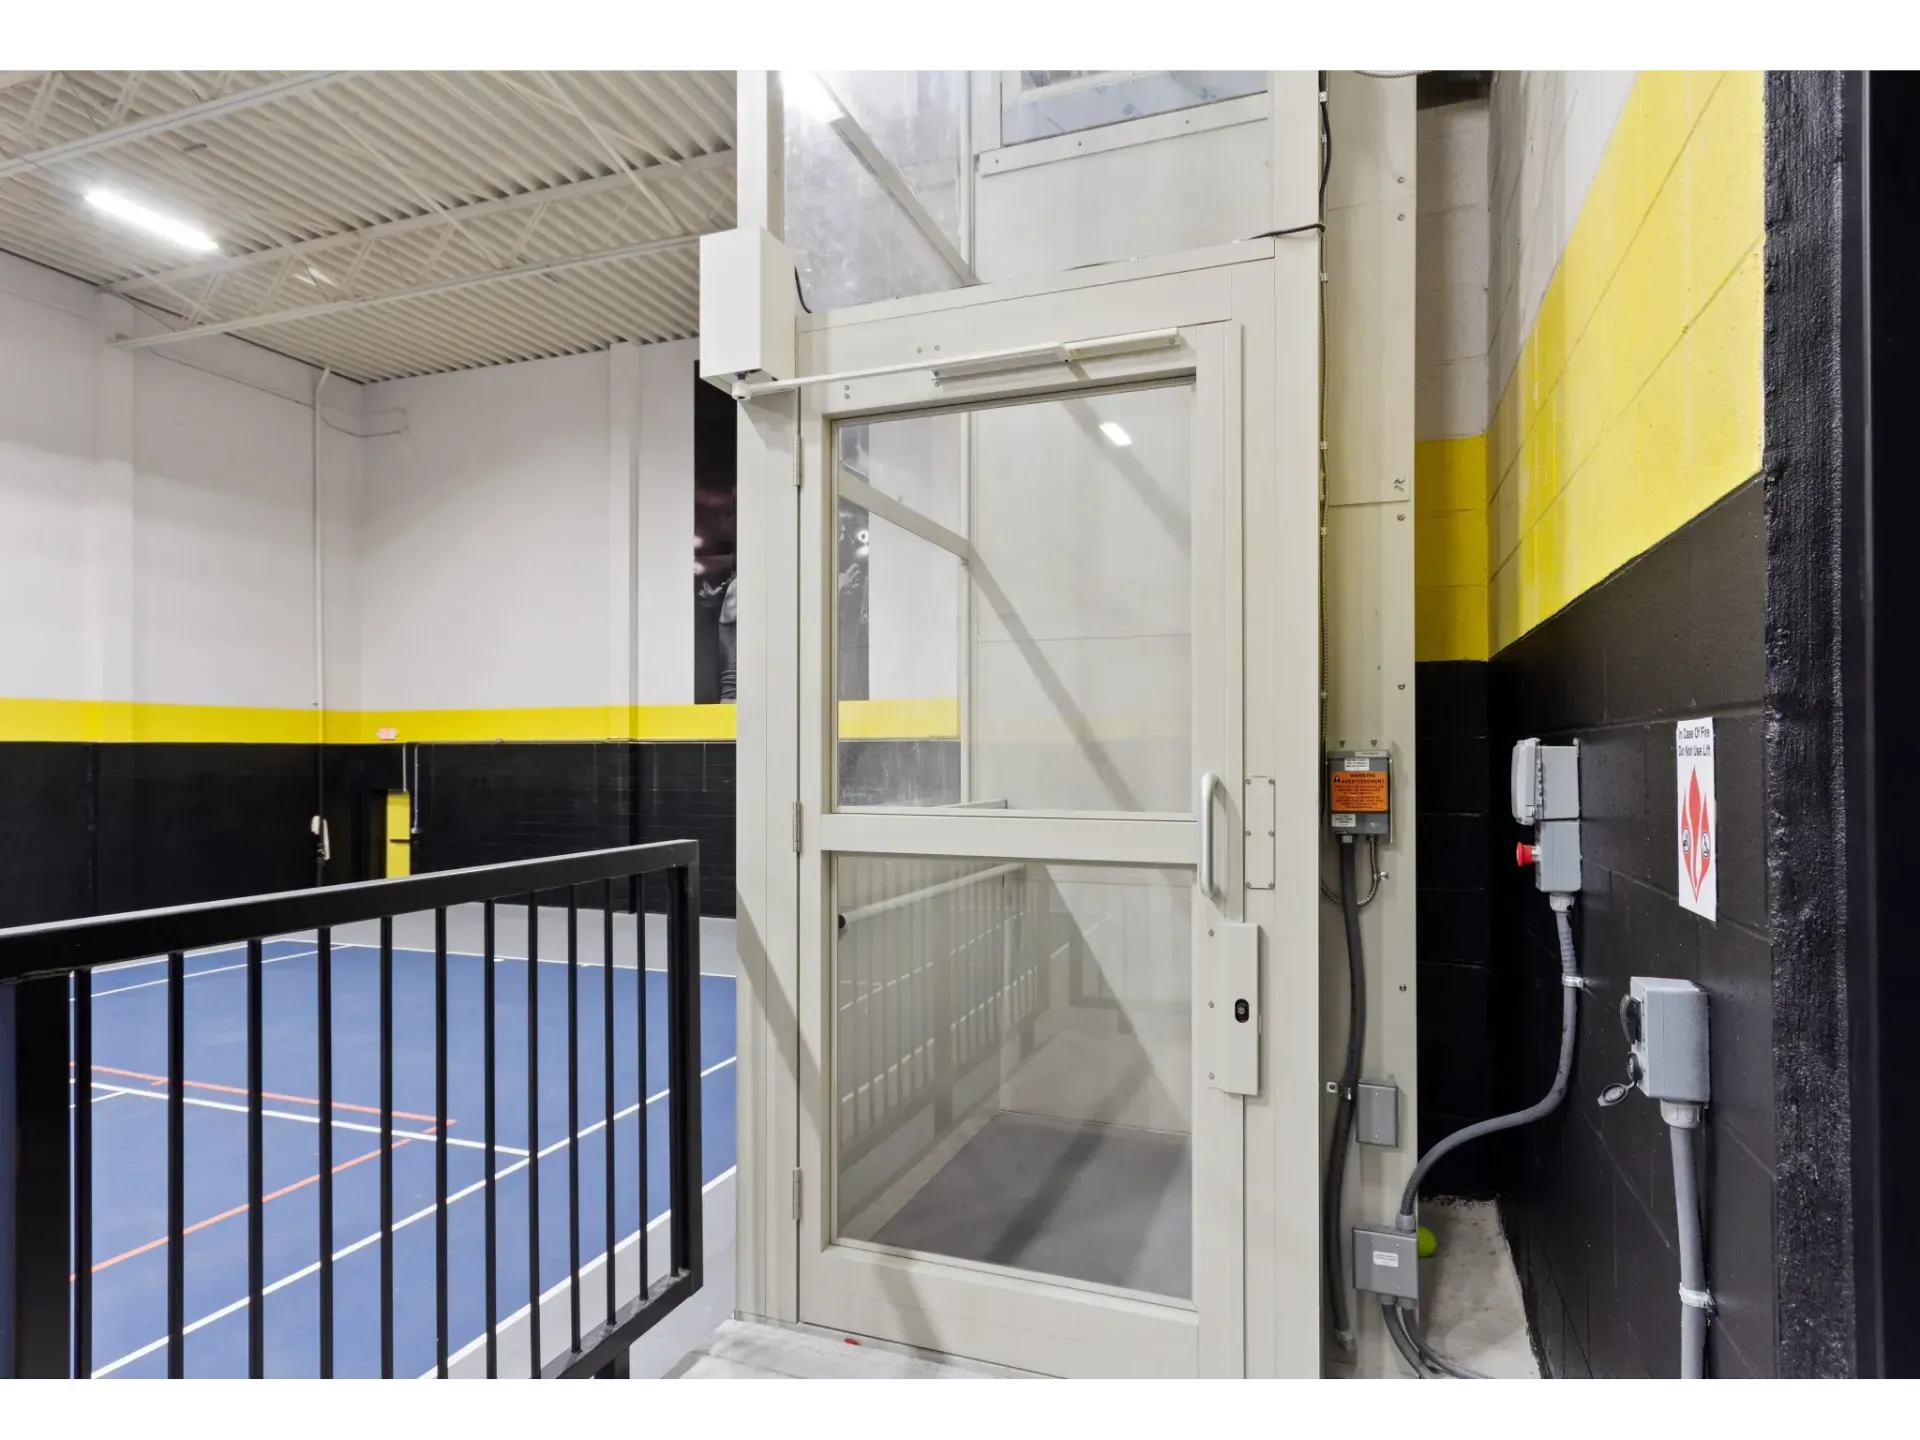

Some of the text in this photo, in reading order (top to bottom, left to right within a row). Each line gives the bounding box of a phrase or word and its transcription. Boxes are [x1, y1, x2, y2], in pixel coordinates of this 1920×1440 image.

[1683, 728, 1693, 739] Case
[1695, 726, 1700, 739] Of
[1701, 726, 1710, 738] Fire
[1678, 744, 1711, 757] Do Not Use Lift
